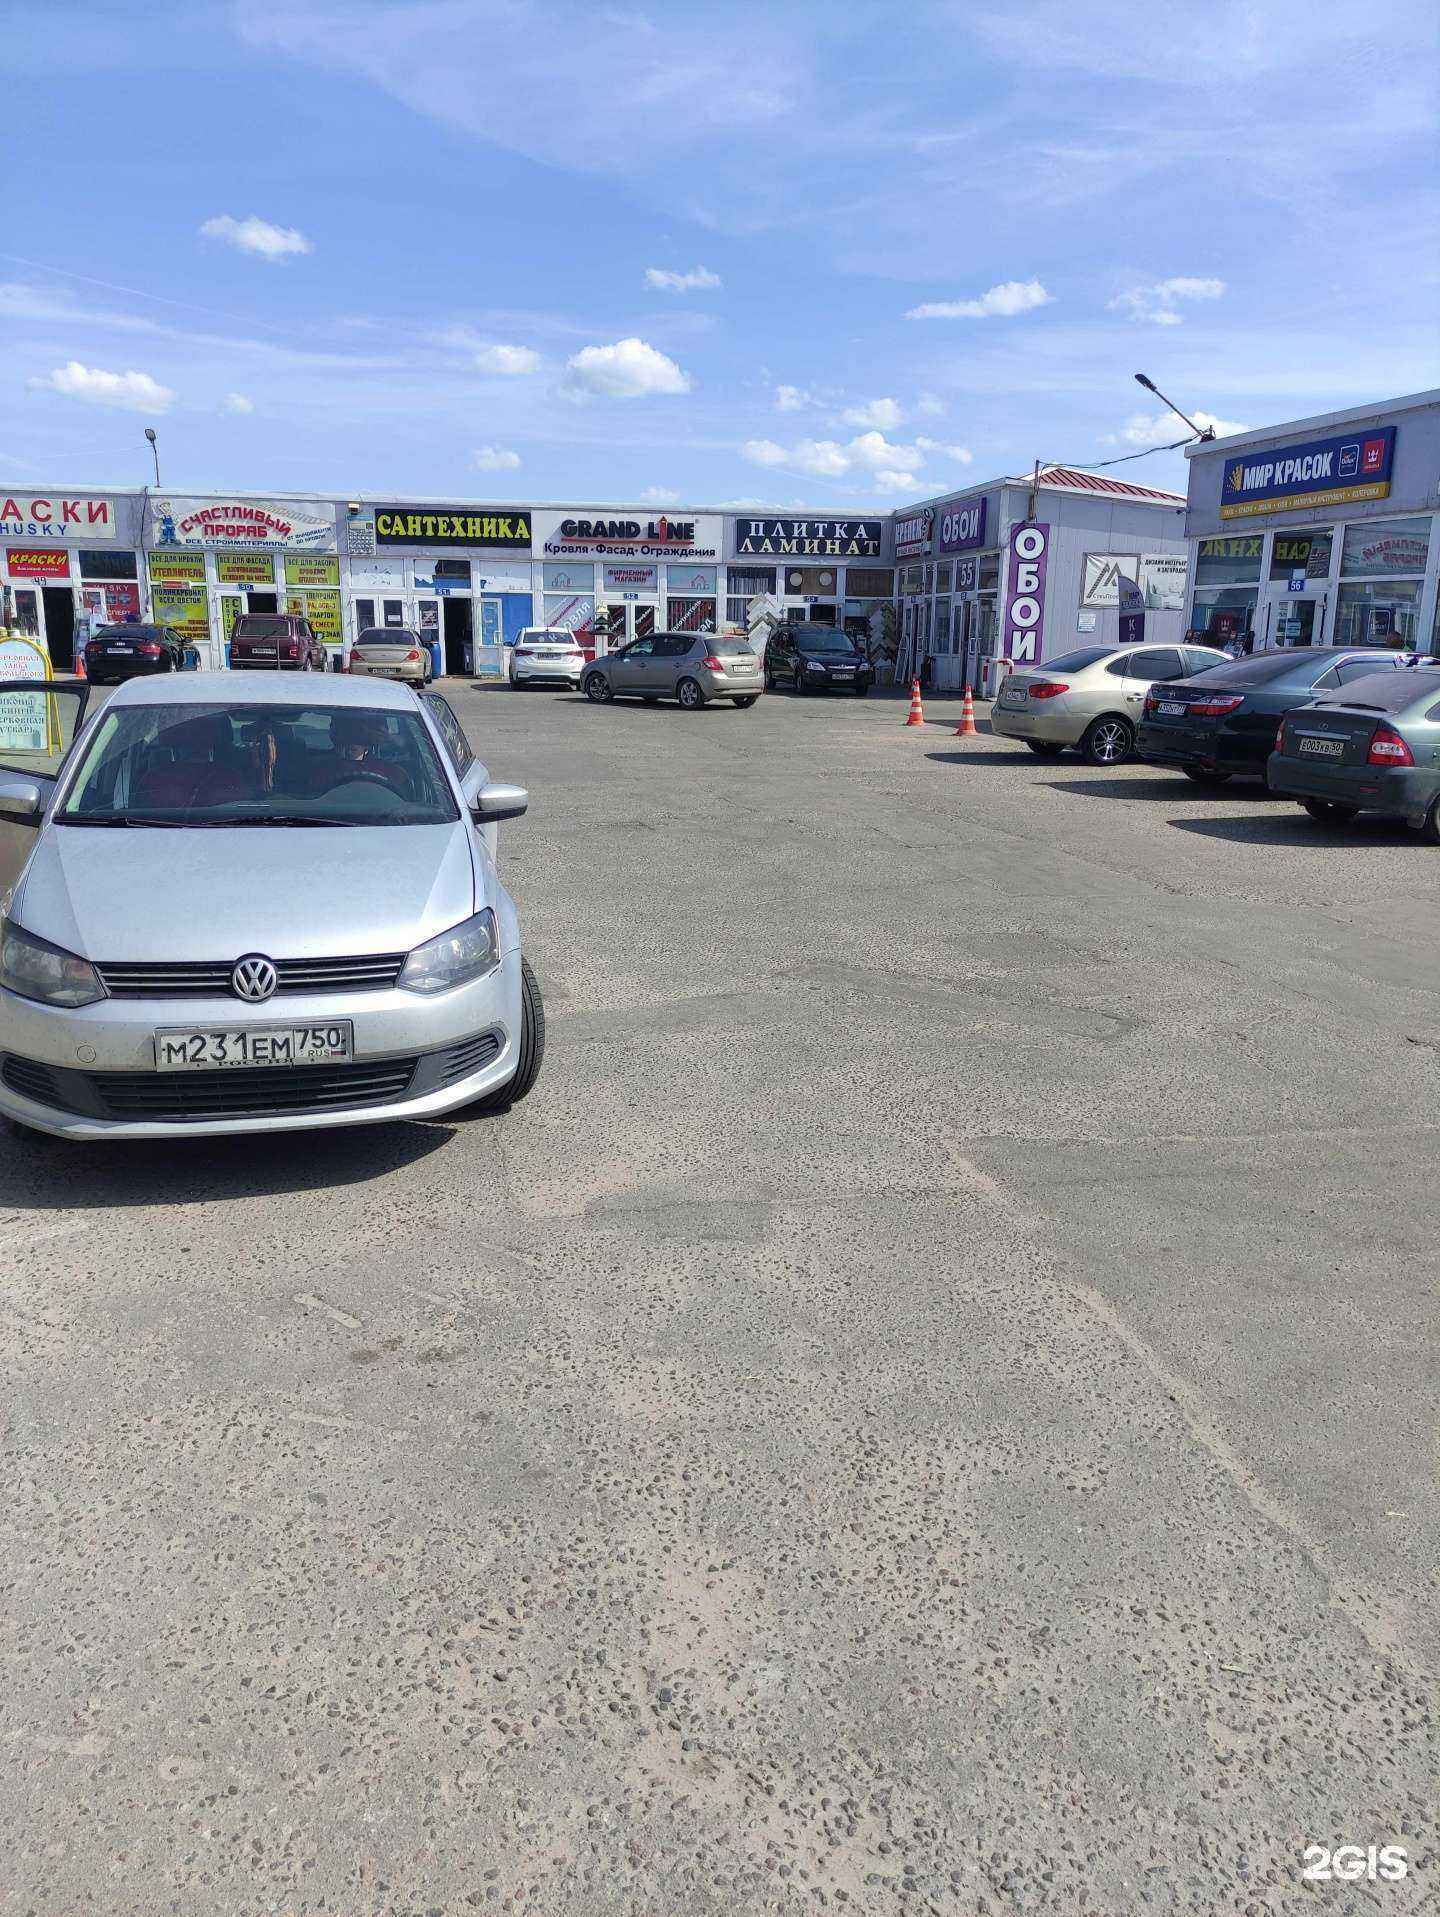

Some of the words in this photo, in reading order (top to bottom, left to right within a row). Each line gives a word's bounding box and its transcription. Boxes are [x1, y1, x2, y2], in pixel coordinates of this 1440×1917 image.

[1243, 463, 1274, 491] МИР
[1274, 451, 1334, 486] КРАСОК
[0, 523, 67, 535] HUSKY
[179, 506, 292, 535] СЧАСТЛИВЫЙ
[377, 514, 530, 539] САНТЕХНИКА
[561, 519, 641, 538] GRAND
[648, 516, 695, 543] LINE
[942, 508, 979, 544] ОБОИ
[203, 524, 268, 538] ПРОРАБ
[748, 521, 870, 539] ПЛИТКА
[544, 543, 589, 556] Кровля
[595, 544, 635, 557] Фасад
[640, 546, 716, 558] Ограждения
[739, 537, 881, 556] ЛАМИНАТ
[8, 553, 68, 565] КРАСКИ
[614, 576, 647, 584] МАГАЗИН
[1290, 581, 1302, 592] 56
[1010, 527, 1045, 662] ОБОИ
[167, 1032, 291, 1064] М231ЕМ
[295, 1028, 341, 1049] 750
[307, 1048, 331, 1058] RUS
